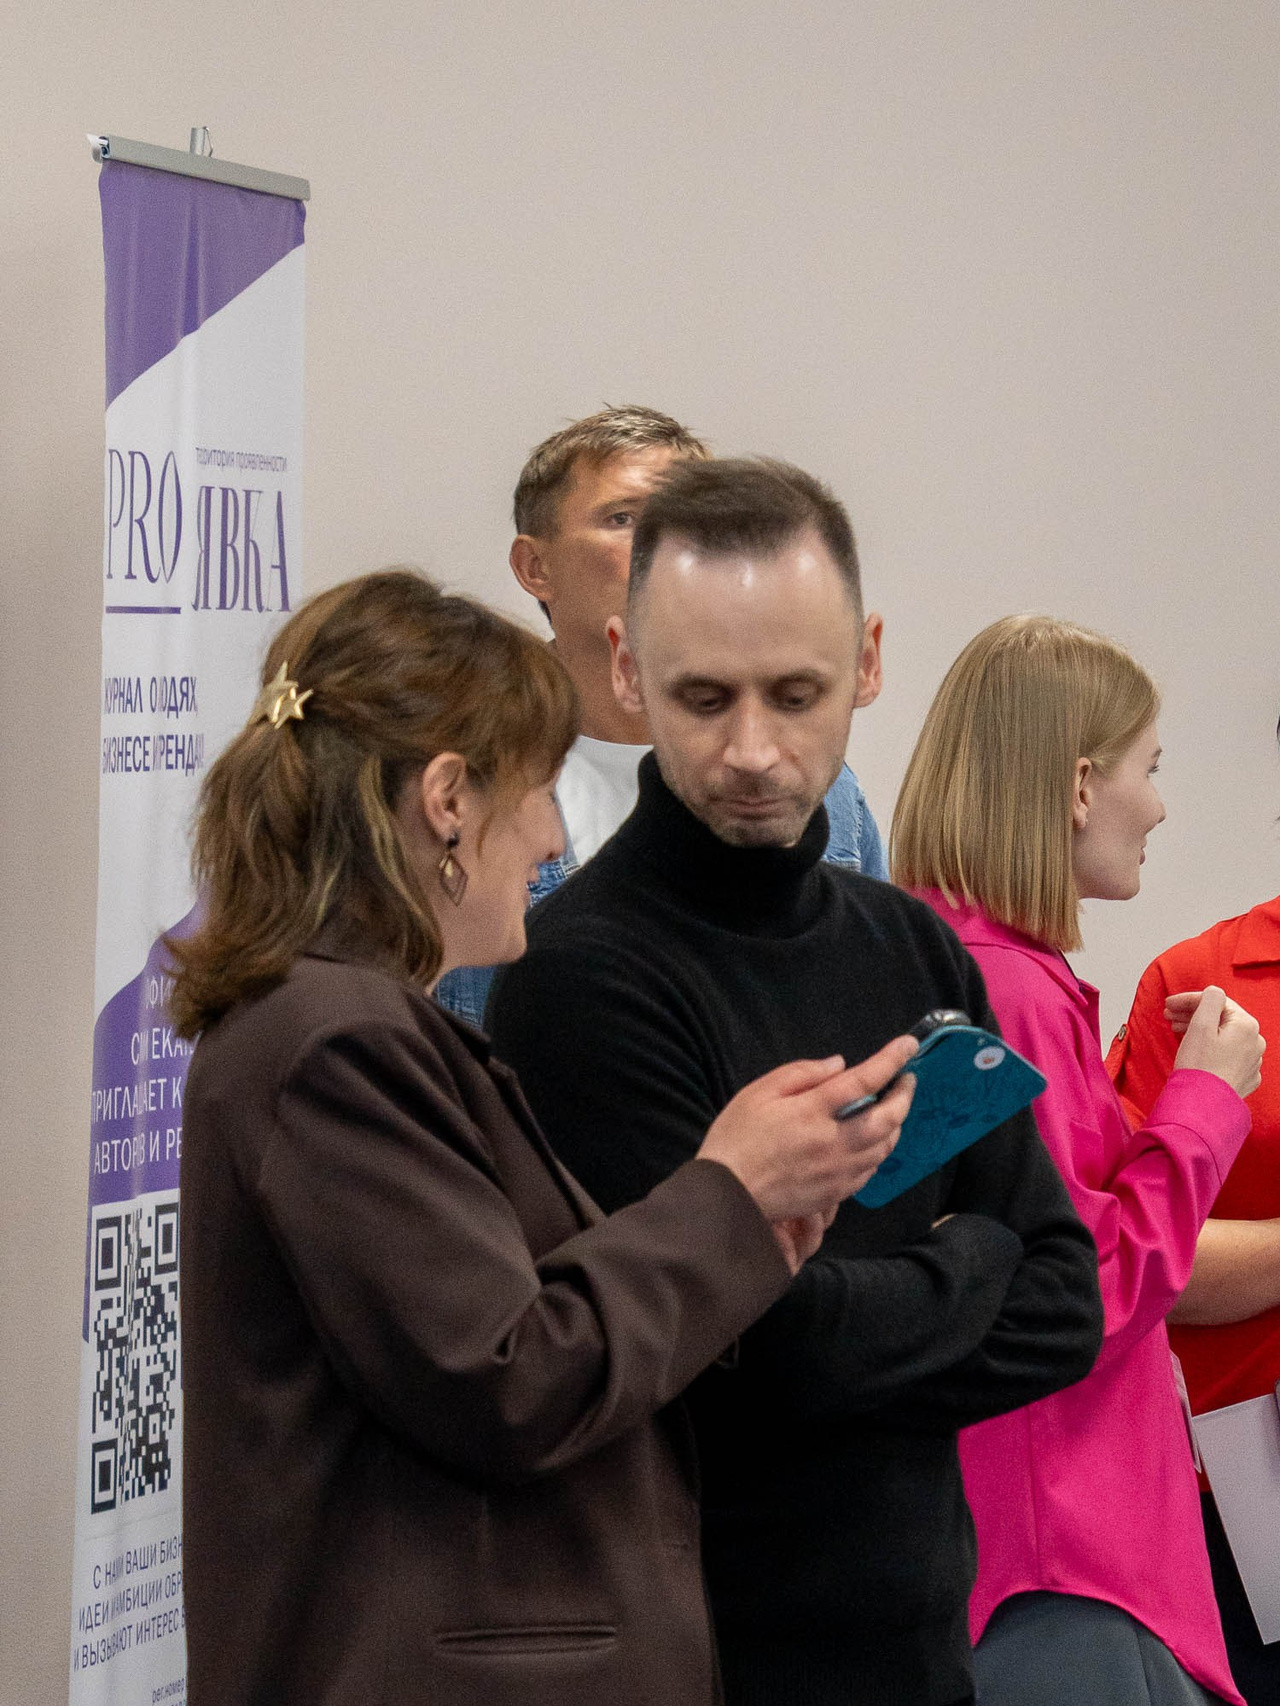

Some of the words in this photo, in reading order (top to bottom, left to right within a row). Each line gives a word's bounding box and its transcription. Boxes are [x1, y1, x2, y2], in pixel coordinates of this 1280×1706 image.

[172, 1076, 182, 1109] К
[149, 1129, 160, 1163] И
[166, 1127, 183, 1161] РЕ
[93, 1564, 101, 1590] С
[126, 1543, 157, 1575] ВАШИ
[160, 1535, 183, 1564] БИЗН
[79, 1600, 109, 1635] ИДЕИ
[164, 1570, 182, 1599] ОБР
[136, 1607, 180, 1645] ИНТЕРЕС
